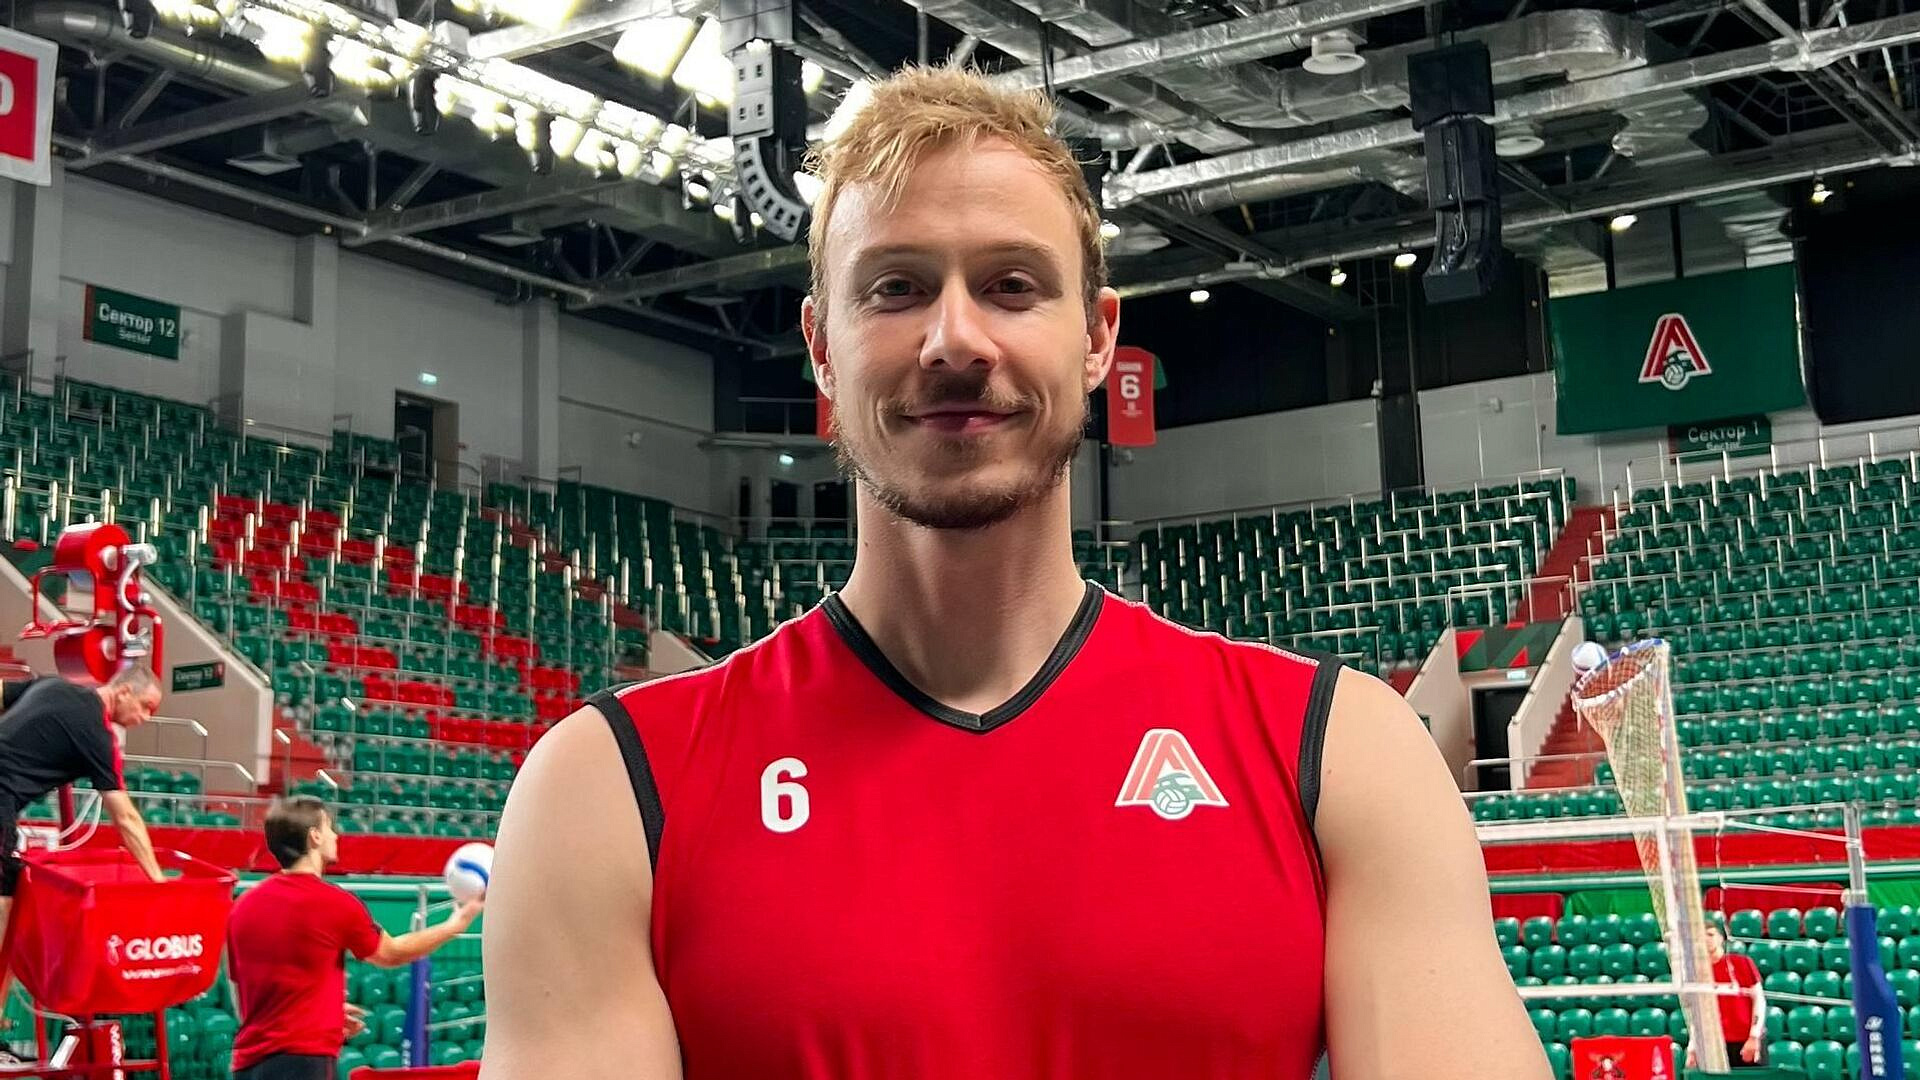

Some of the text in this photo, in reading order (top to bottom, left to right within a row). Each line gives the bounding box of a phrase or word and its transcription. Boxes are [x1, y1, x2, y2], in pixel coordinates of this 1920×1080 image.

[99, 302, 175, 338] Сектор 12
[1120, 374, 1140, 400] 6
[1688, 420, 1759, 443] Сектор 1
[760, 757, 810, 833] 6
[125, 934, 203, 961] GLOBUS
